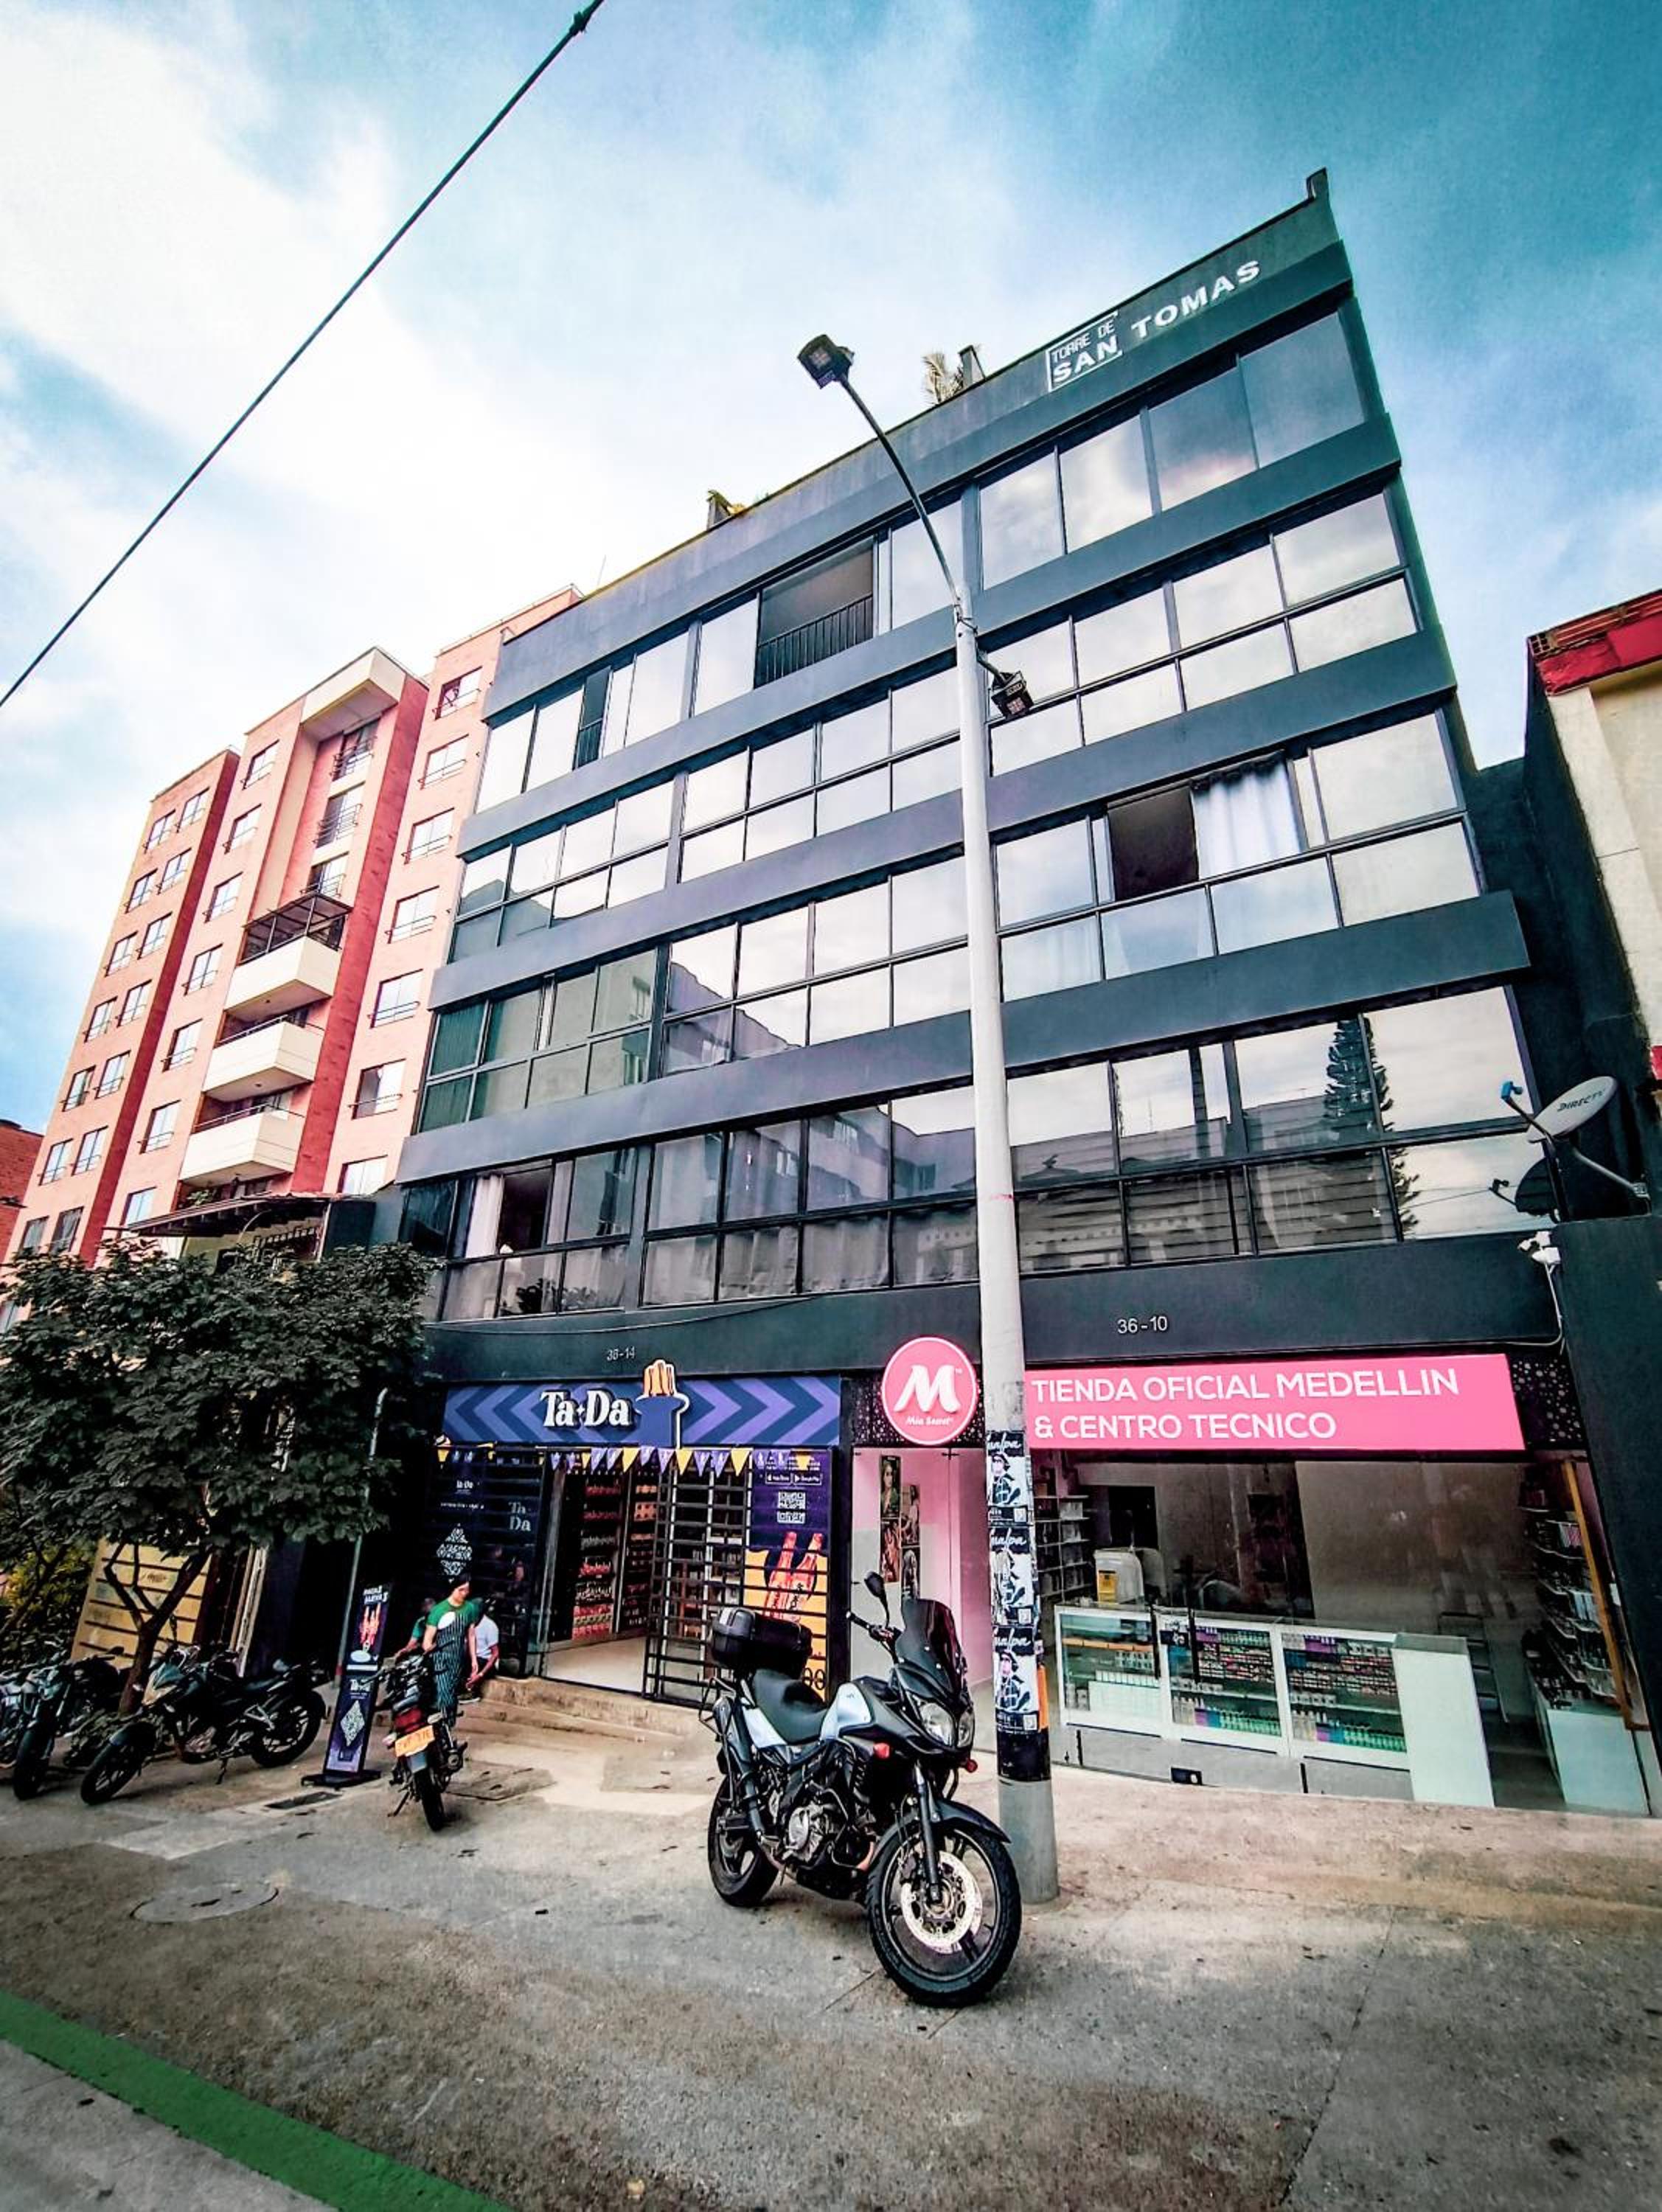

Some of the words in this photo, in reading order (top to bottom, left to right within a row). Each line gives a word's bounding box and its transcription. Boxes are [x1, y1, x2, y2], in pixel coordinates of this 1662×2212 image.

[1052, 335, 1119, 384] SAN
[1130, 260, 1260, 339] TOMAS
[1052, 333, 1091, 364] TORRE
[1098, 320, 1116, 338] DE
[1117, 1316, 1168, 1334] 36-10
[1032, 1378, 1137, 1402] TIENDA
[1144, 1373, 1270, 1401] OFICIAL
[1276, 1368, 1459, 1399] MEDELLIN
[1035, 1415, 1054, 1439] &
[1060, 1413, 1181, 1439] CENTRO
[1189, 1413, 1337, 1439] TECNICO
